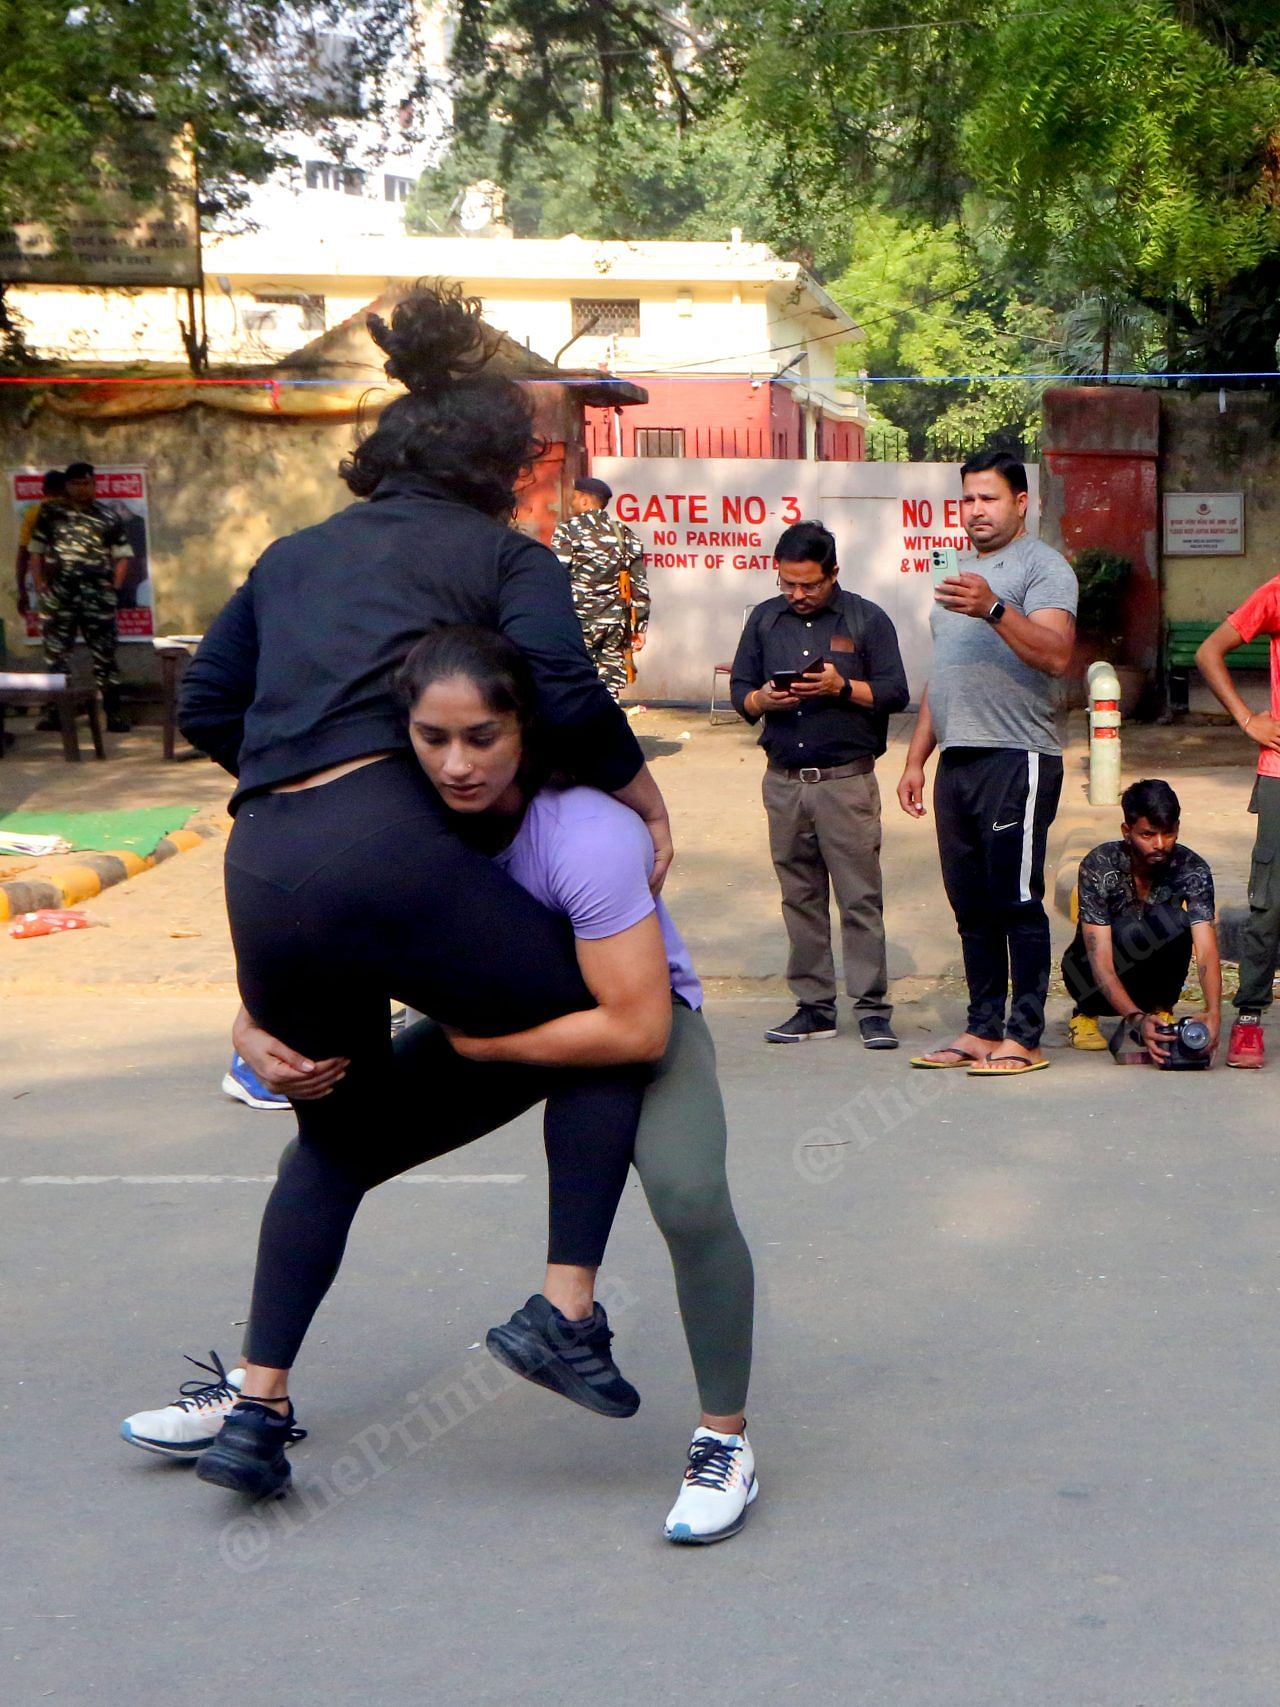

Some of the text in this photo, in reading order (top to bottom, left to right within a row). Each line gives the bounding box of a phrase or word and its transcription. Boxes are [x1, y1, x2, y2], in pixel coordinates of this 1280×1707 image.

[615, 493, 709, 524] GATE
[902, 499, 965, 528] NO E
[653, 530, 762, 547] NO PARKING
[903, 536, 973, 551] WITHOUT
[642, 553, 699, 569] FRONT
[704, 554, 725, 570] OF
[900, 558, 931, 573] & WI
